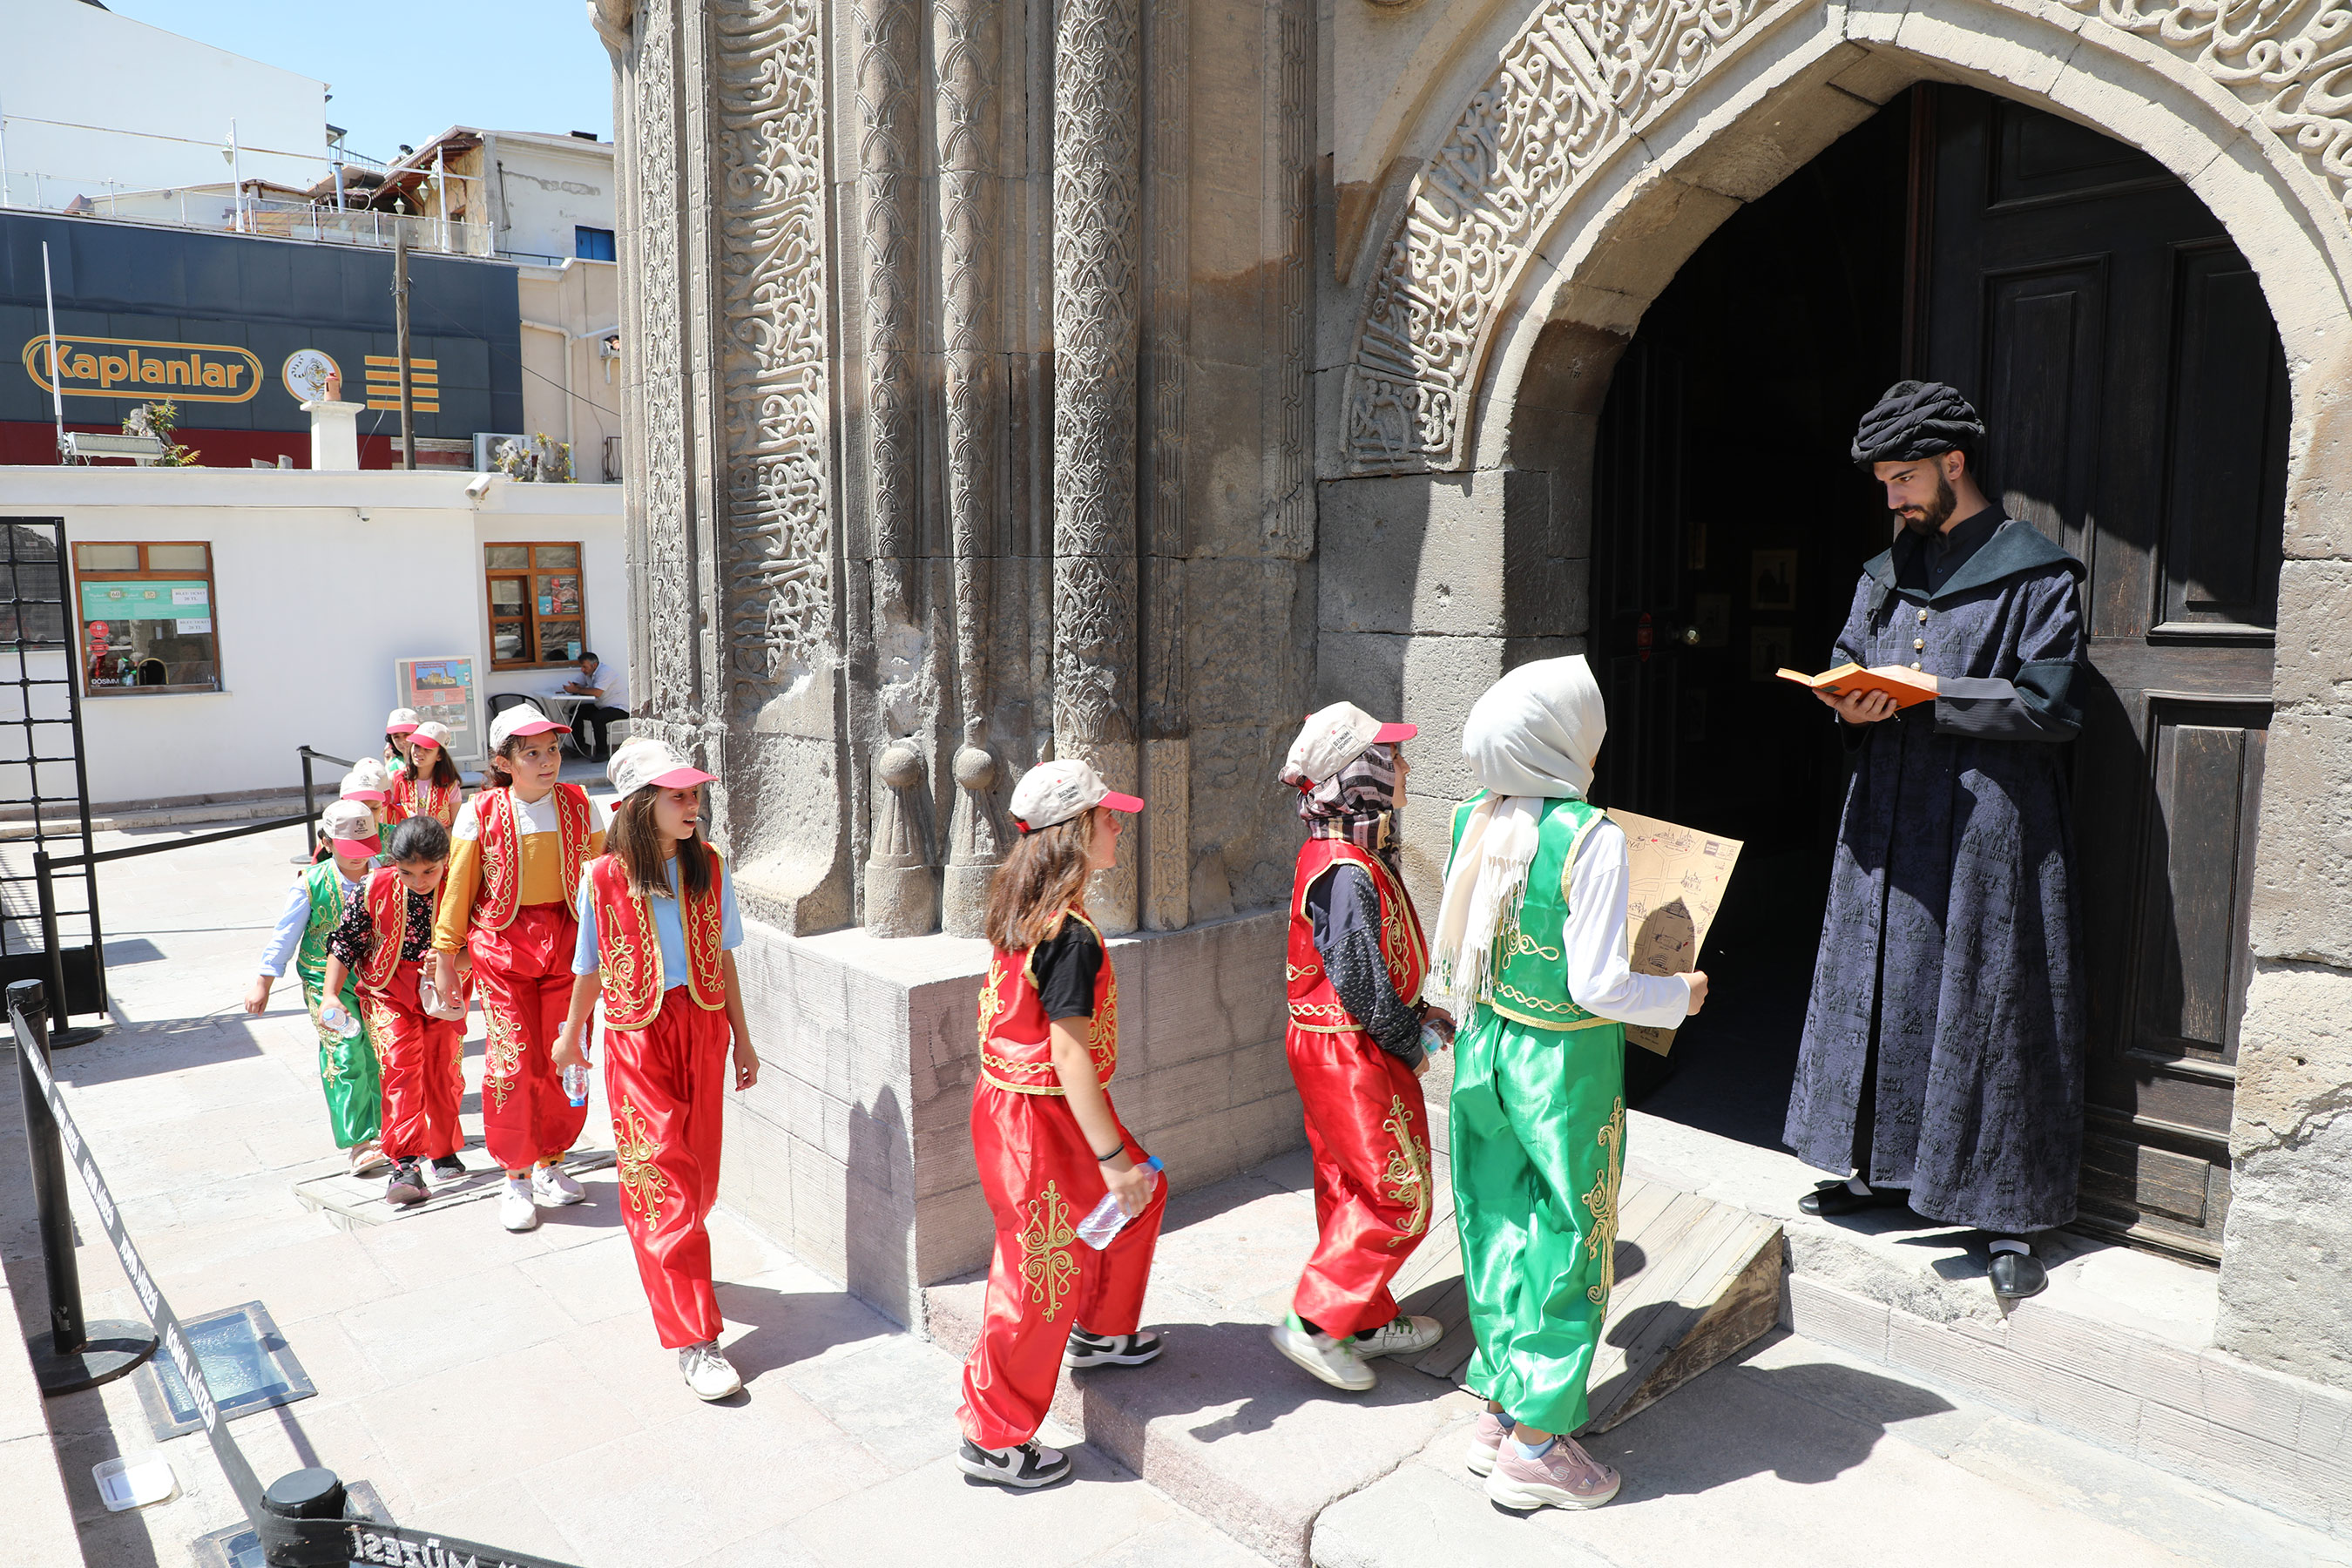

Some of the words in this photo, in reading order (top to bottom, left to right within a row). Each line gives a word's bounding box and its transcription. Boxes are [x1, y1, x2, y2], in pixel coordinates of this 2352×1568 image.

[44, 344, 244, 388] Kaplanlar
[82, 1158, 98, 1200] KONYA
[95, 1185, 115, 1229] MÜZESİ
[118, 1233, 138, 1274] KONYA
[135, 1267, 159, 1320] MÜZESİ
[166, 1322, 188, 1380] KONYA
[188, 1366, 216, 1434] MÜZESİ
